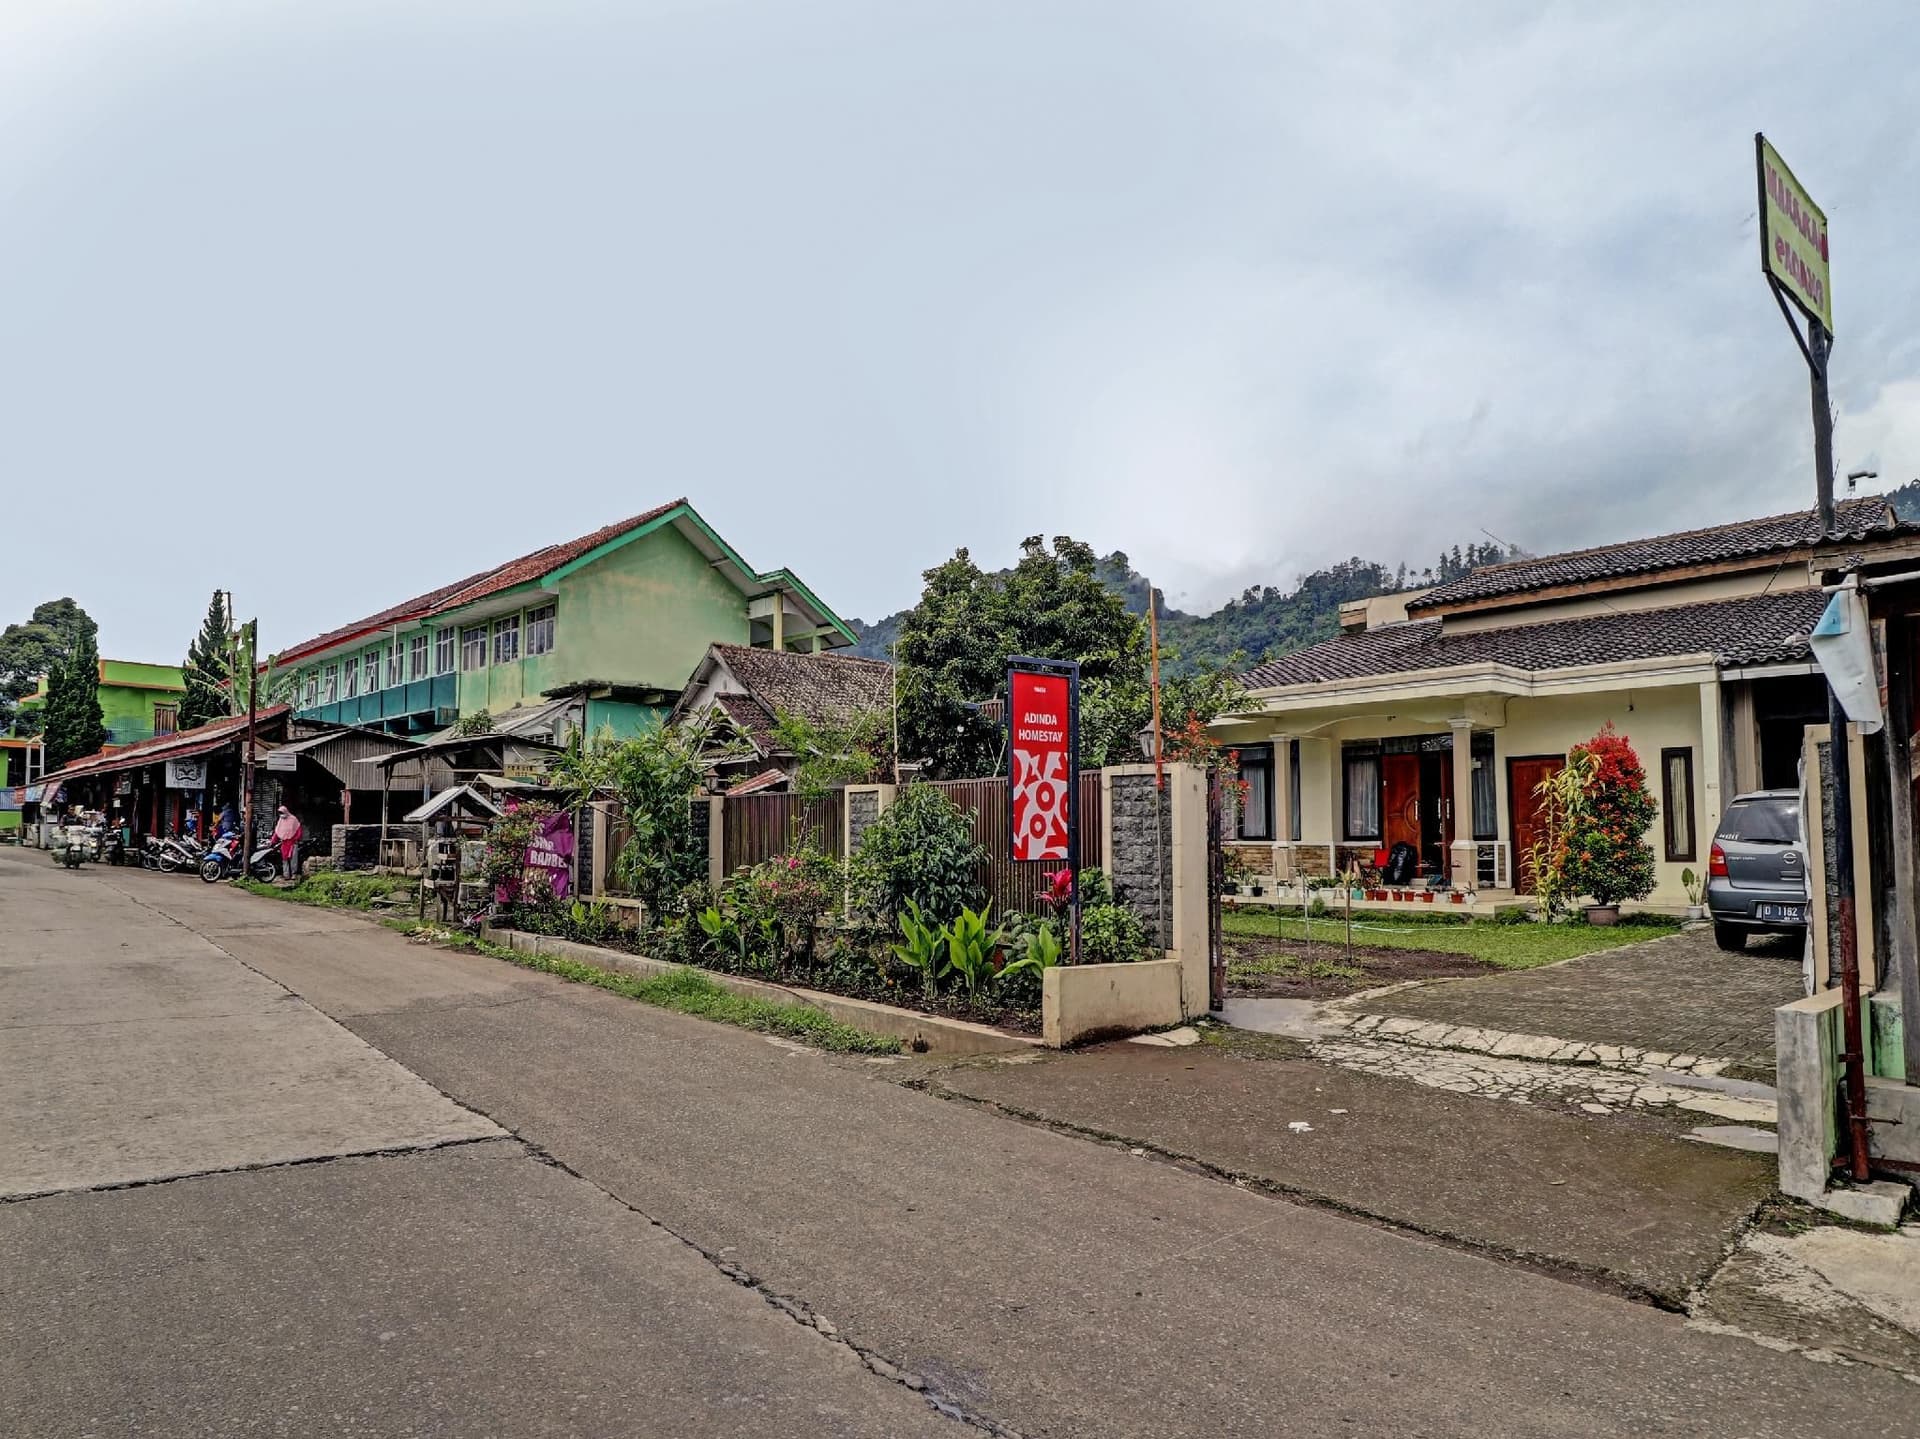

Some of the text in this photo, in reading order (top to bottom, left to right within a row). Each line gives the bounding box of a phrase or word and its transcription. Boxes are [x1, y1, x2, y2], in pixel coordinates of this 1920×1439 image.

[1024, 712, 1057, 725] ADINDA
[1019, 729, 1063, 742] HOMESTAY
[1765, 906, 1771, 915] D
